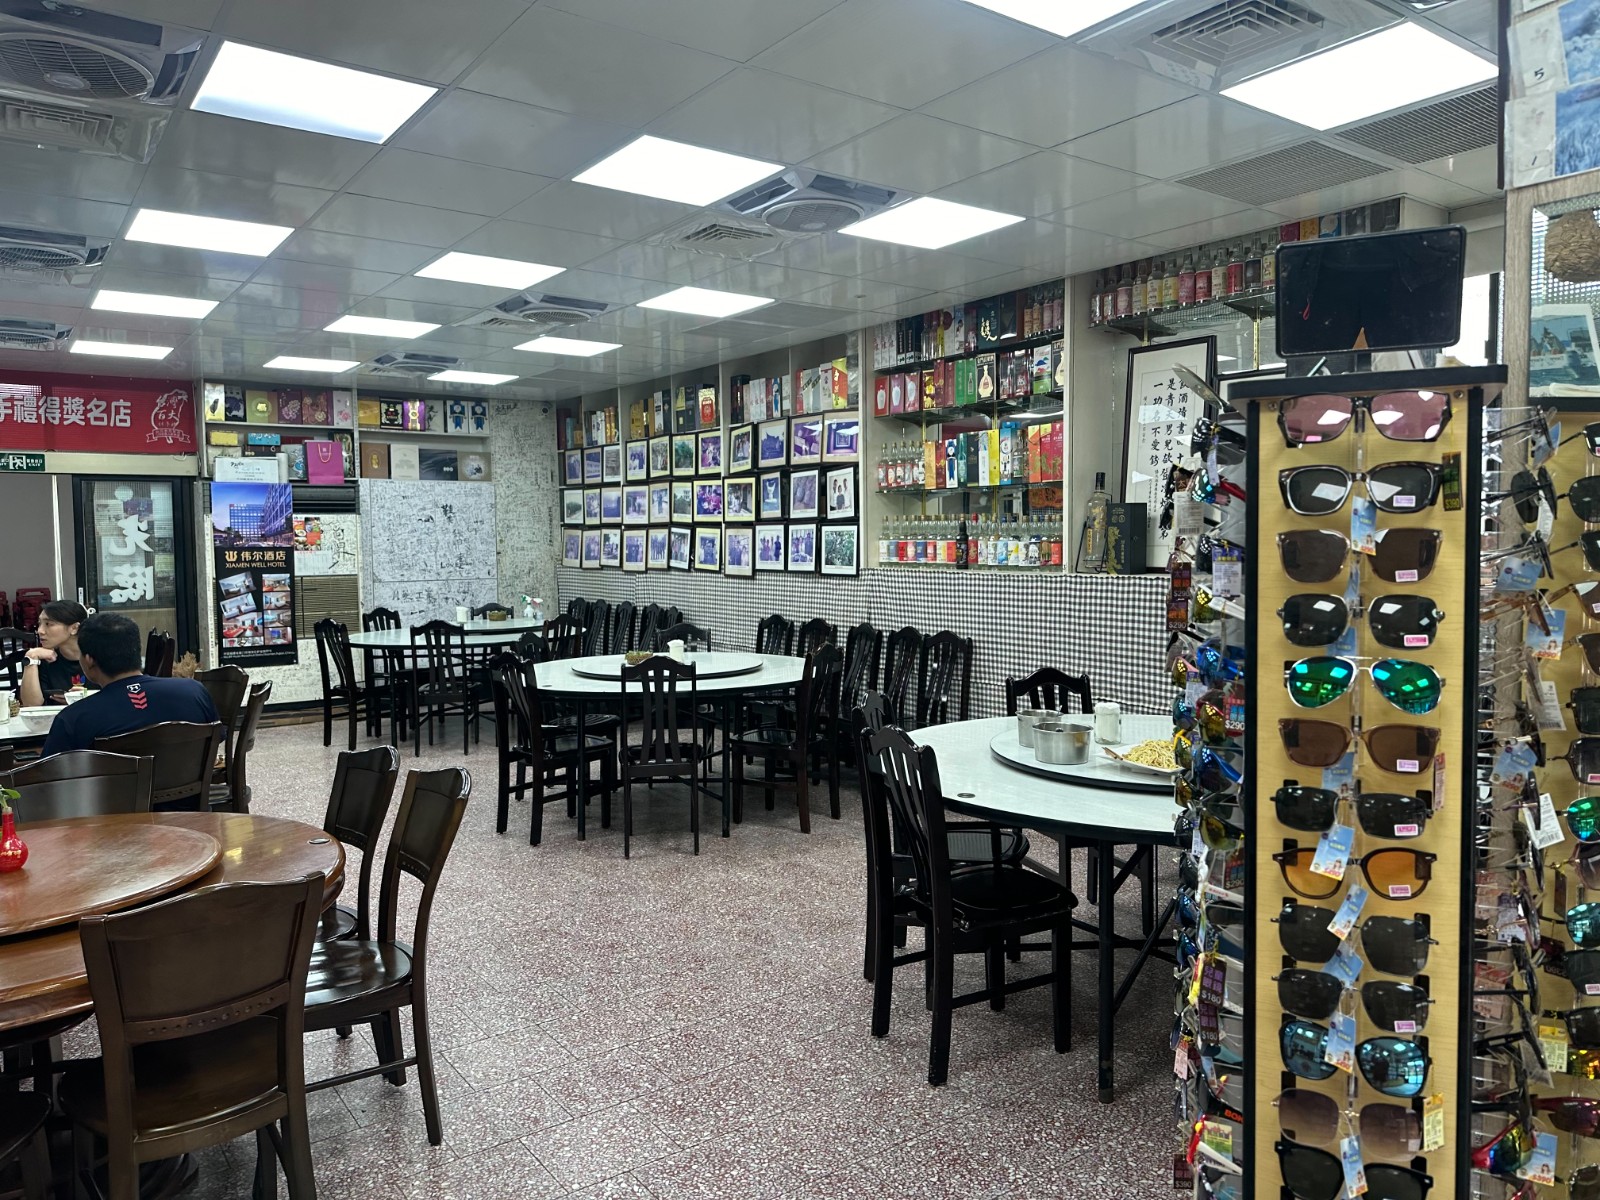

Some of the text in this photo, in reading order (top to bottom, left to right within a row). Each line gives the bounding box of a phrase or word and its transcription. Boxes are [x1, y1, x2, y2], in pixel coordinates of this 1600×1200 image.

[1534, 68, 1545, 80] 5
[241, 550, 287, 561] 伟尔酒店
[1224, 719, 1246, 731] $290
[1201, 990, 1222, 1004] $180
[1201, 1030, 1218, 1040] $180
